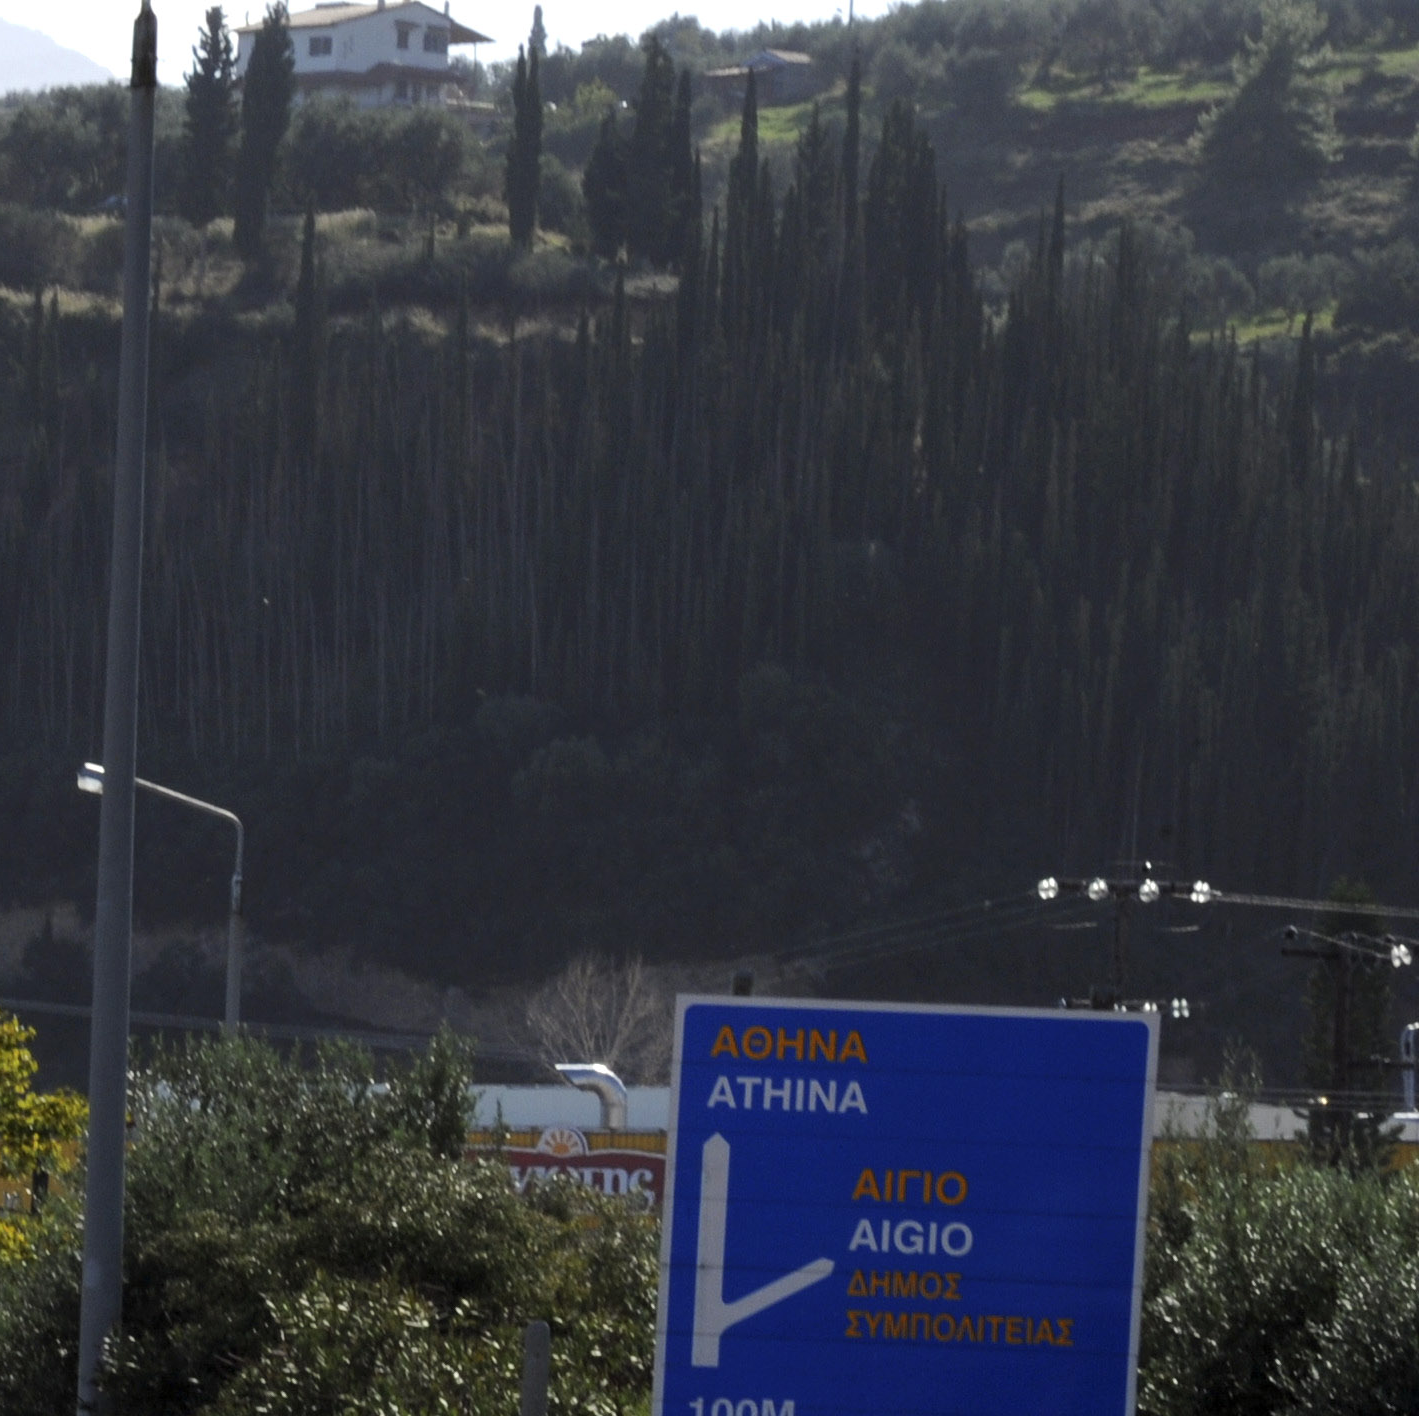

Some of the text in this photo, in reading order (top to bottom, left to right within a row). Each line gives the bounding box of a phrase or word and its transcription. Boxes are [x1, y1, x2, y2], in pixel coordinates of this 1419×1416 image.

[710, 1025, 868, 1063] ΑΘΗΝΑ
[707, 1075, 868, 1114] ATHINA
[853, 1168, 969, 1205] ΑΙΓΙΟ
[849, 1219, 974, 1257] AIGIO
[846, 1270, 963, 1301] ΔΗΜΟΣ
[844, 1309, 1075, 1347] ΣΥΜΠΟΛΙΤΕΙΑΣ
